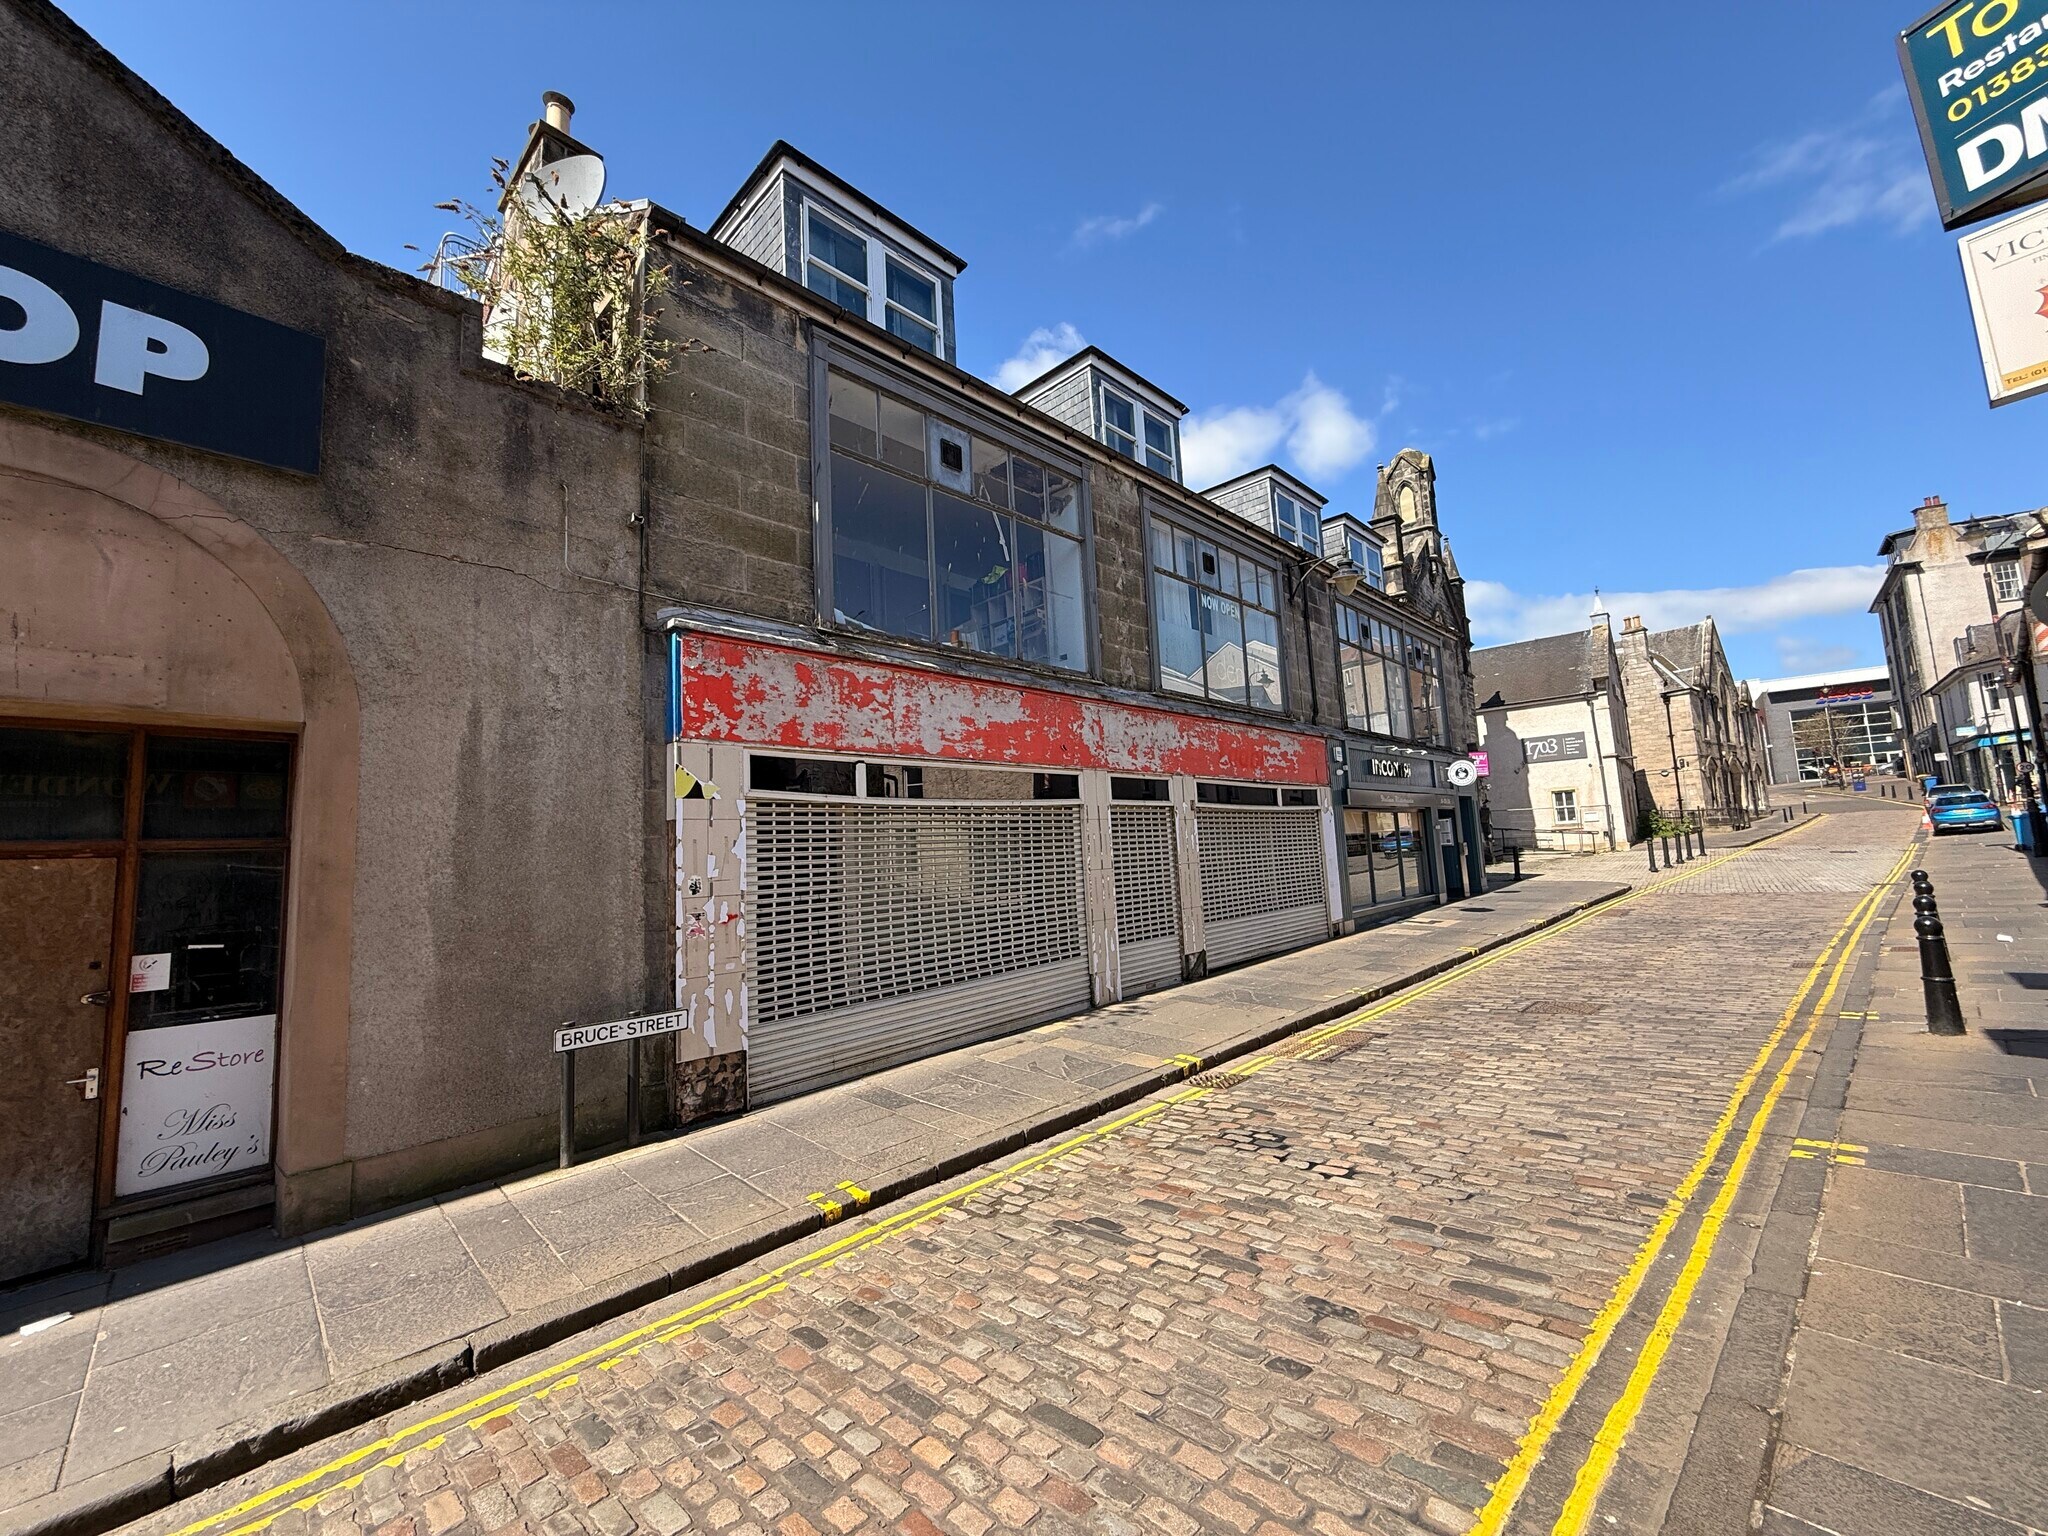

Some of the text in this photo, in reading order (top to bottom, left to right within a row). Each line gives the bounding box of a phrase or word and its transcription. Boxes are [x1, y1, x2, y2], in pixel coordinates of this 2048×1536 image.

[1926, 0, 2019, 58] TO
[1937, 13, 2048, 98] Resta
[1981, 226, 2048, 263] VIC
[2031, 366, 2048, 377] (01
[1201, 593, 1240, 620] NOW OPEN
[1524, 738, 1558, 760] 1703
[561, 1013, 683, 1048] BRUCE STREET
[156, 1103, 237, 1140] Miss
